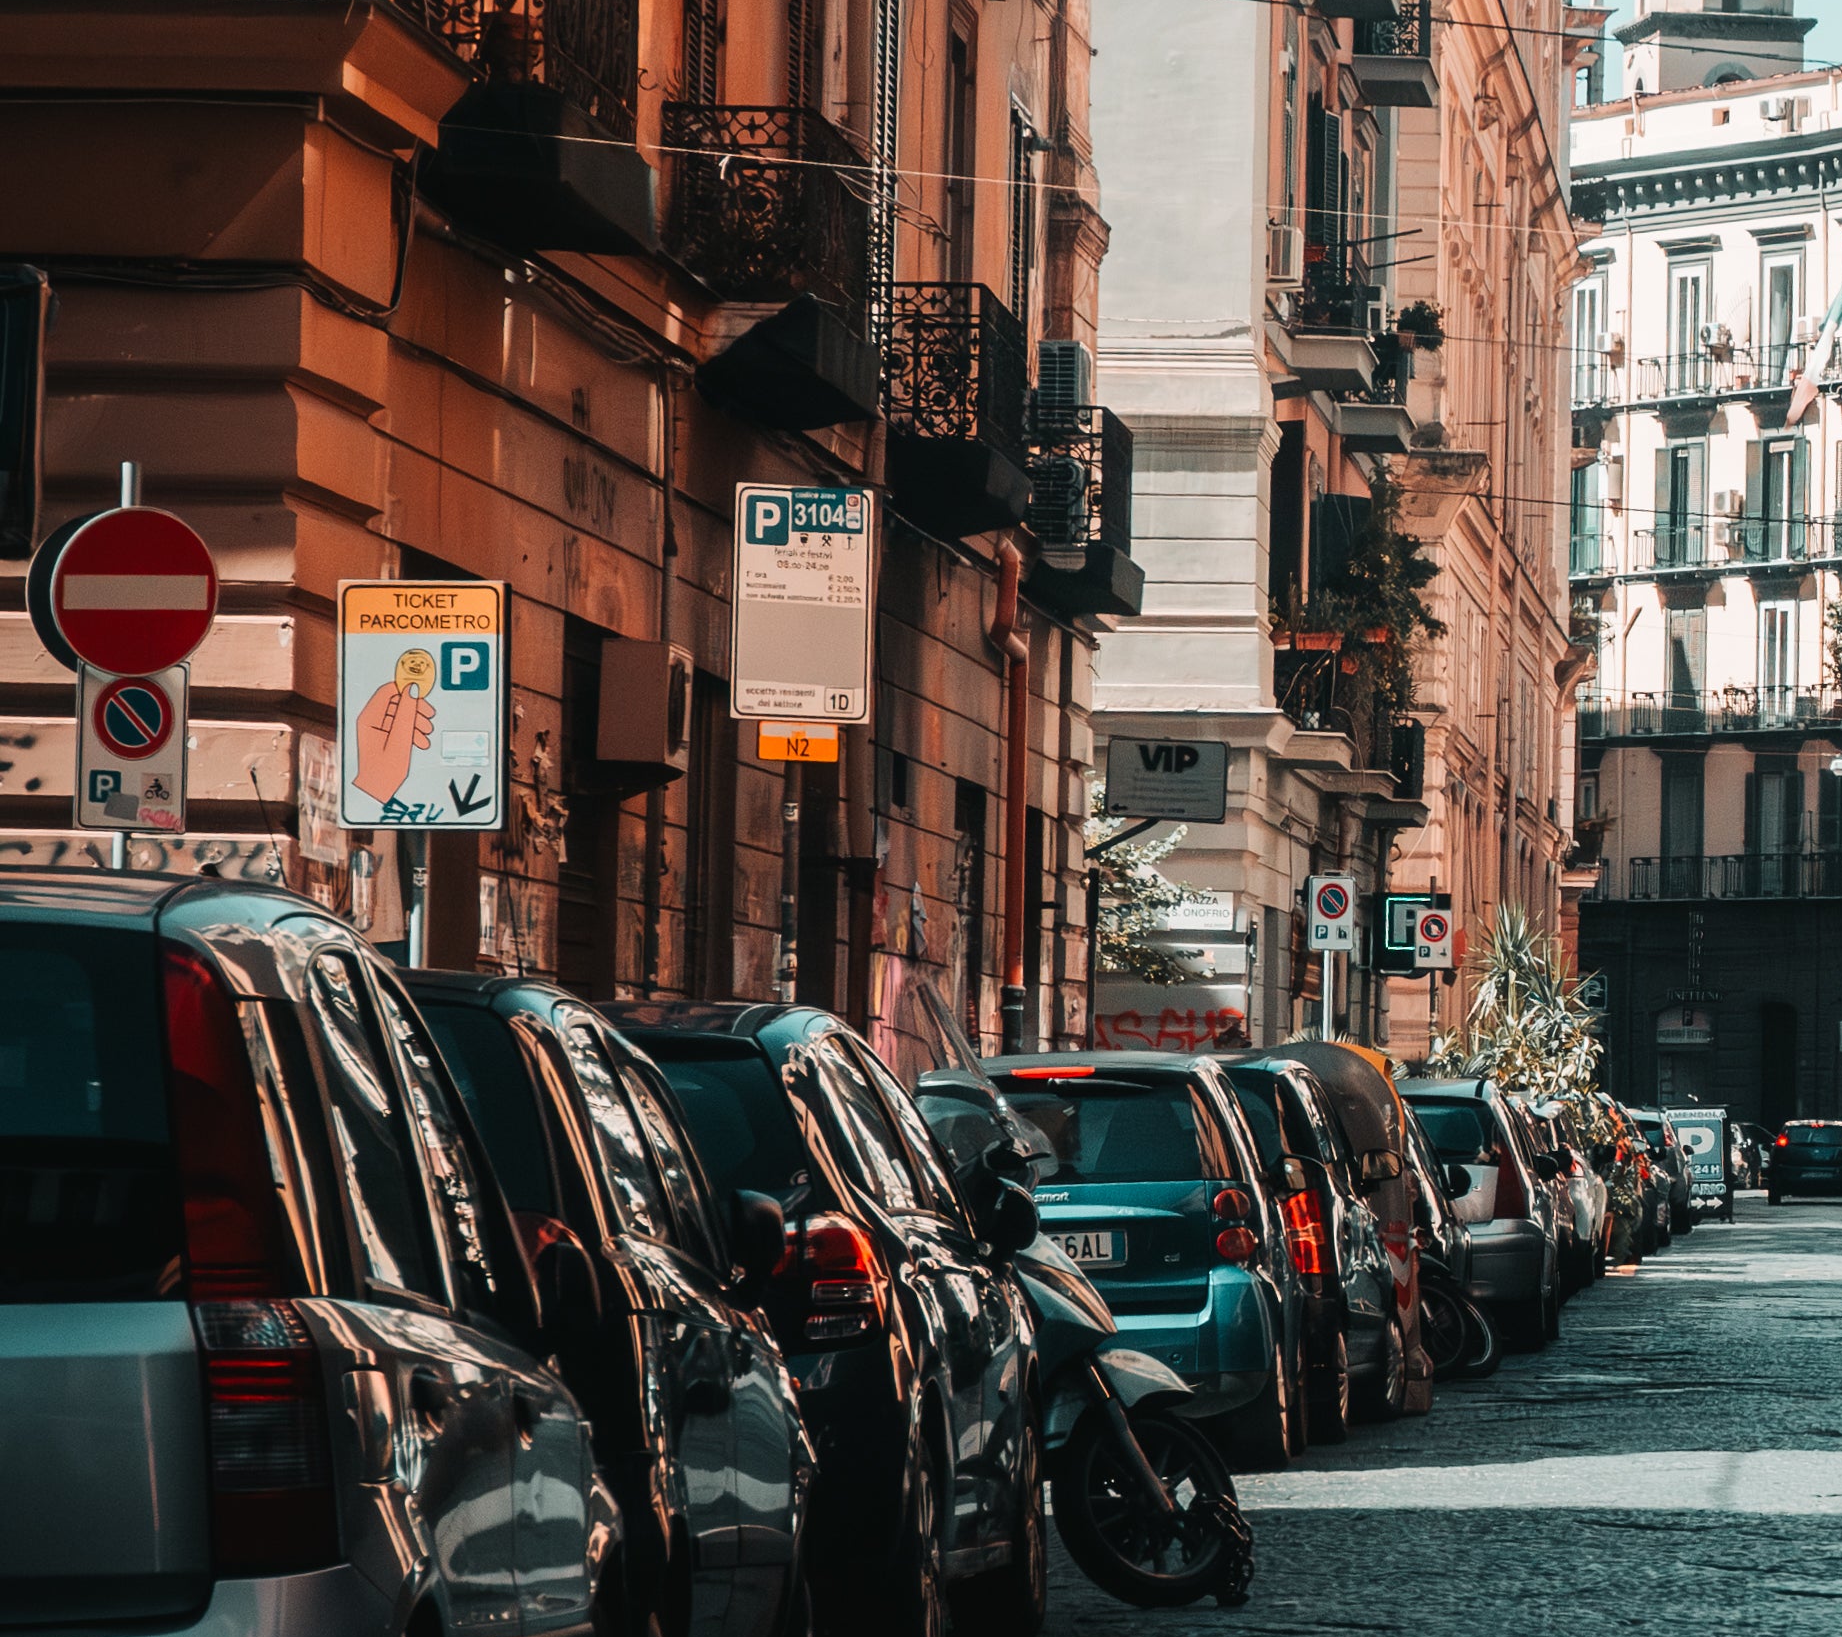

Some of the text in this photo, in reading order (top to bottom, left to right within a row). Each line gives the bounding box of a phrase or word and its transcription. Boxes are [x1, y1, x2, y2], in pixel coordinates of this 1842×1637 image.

[755, 501, 781, 539] P
[393, 593, 458, 609] TICKET
[360, 613, 491, 630] PARCOMETRO
[451, 648, 480, 685] P
[829, 693, 850, 711] 1D
[786, 737, 810, 757] N2
[1138, 744, 1199, 773] VIP
[1183, 908, 1230, 918] ONOFRIO
[1667, 1111, 1727, 1119] AMENDOLA
[1034, 1191, 1070, 1203] smart
